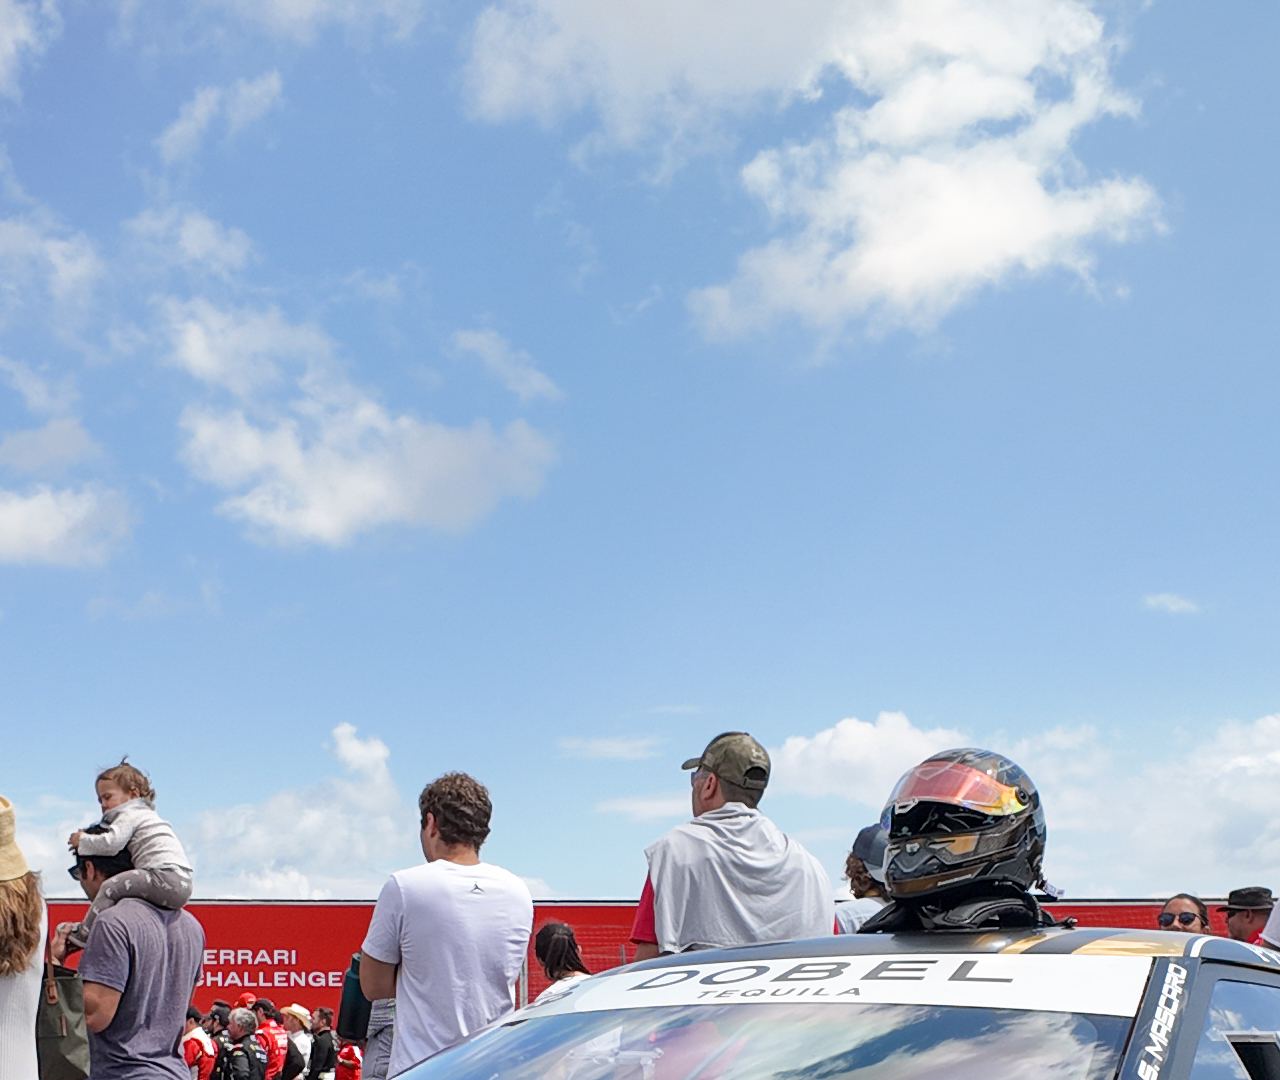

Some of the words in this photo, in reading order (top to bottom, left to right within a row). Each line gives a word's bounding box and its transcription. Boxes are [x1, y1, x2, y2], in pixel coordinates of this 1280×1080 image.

[203, 949, 297, 965] ERRARI
[626, 959, 1014, 991] DOBEL
[697, 987, 861, 999] TEQUILA
[1144, 962, 1188, 1062] MASCARO
